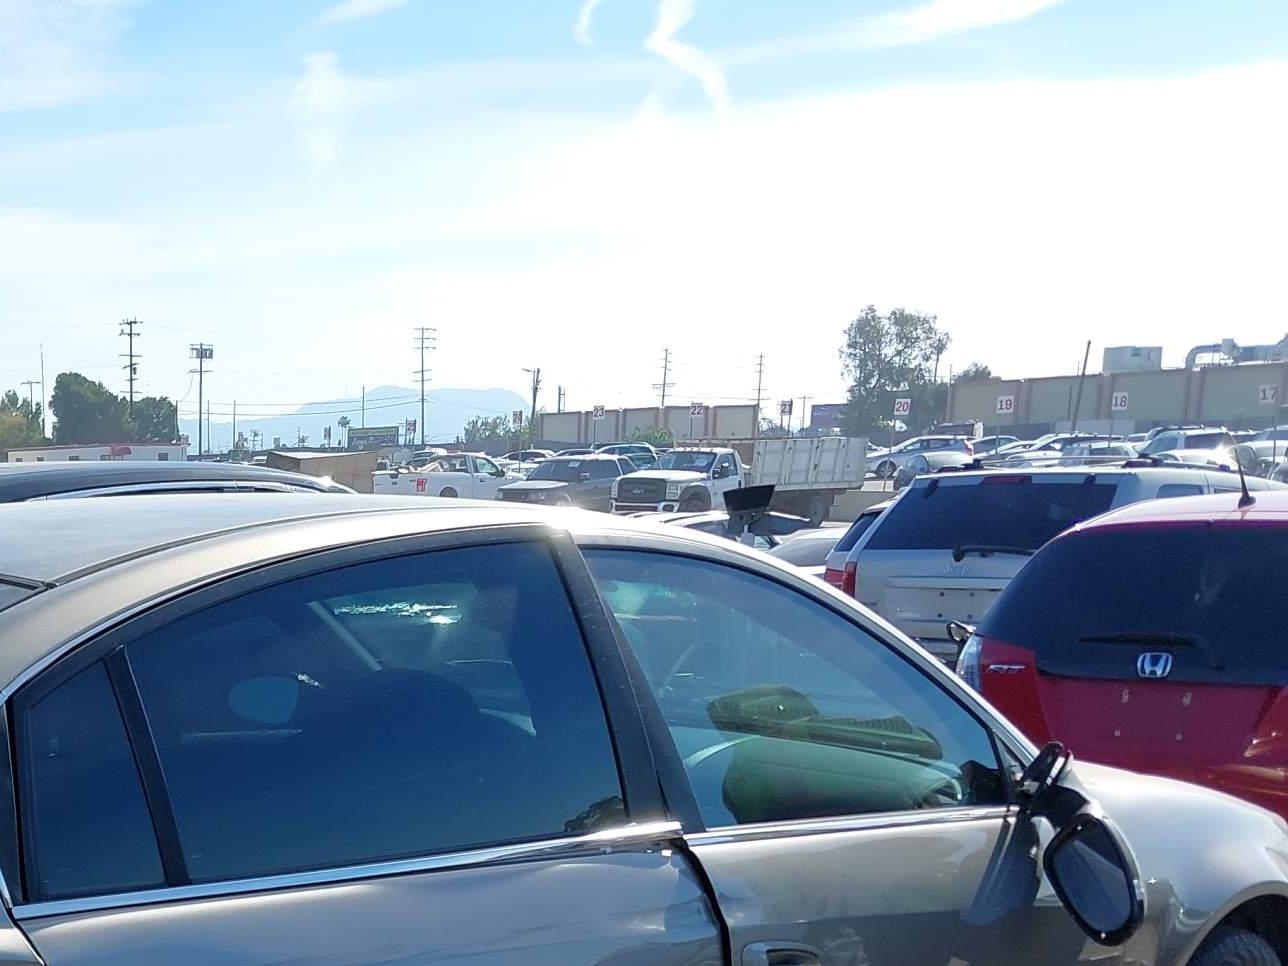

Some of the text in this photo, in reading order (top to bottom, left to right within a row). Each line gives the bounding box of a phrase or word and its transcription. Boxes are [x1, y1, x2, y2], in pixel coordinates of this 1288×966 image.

[895, 401, 909, 413] 20
[998, 398, 1013, 411] 19
[1112, 395, 1128, 408] 18
[593, 407, 605, 418] 23
[691, 405, 703, 415] 22
